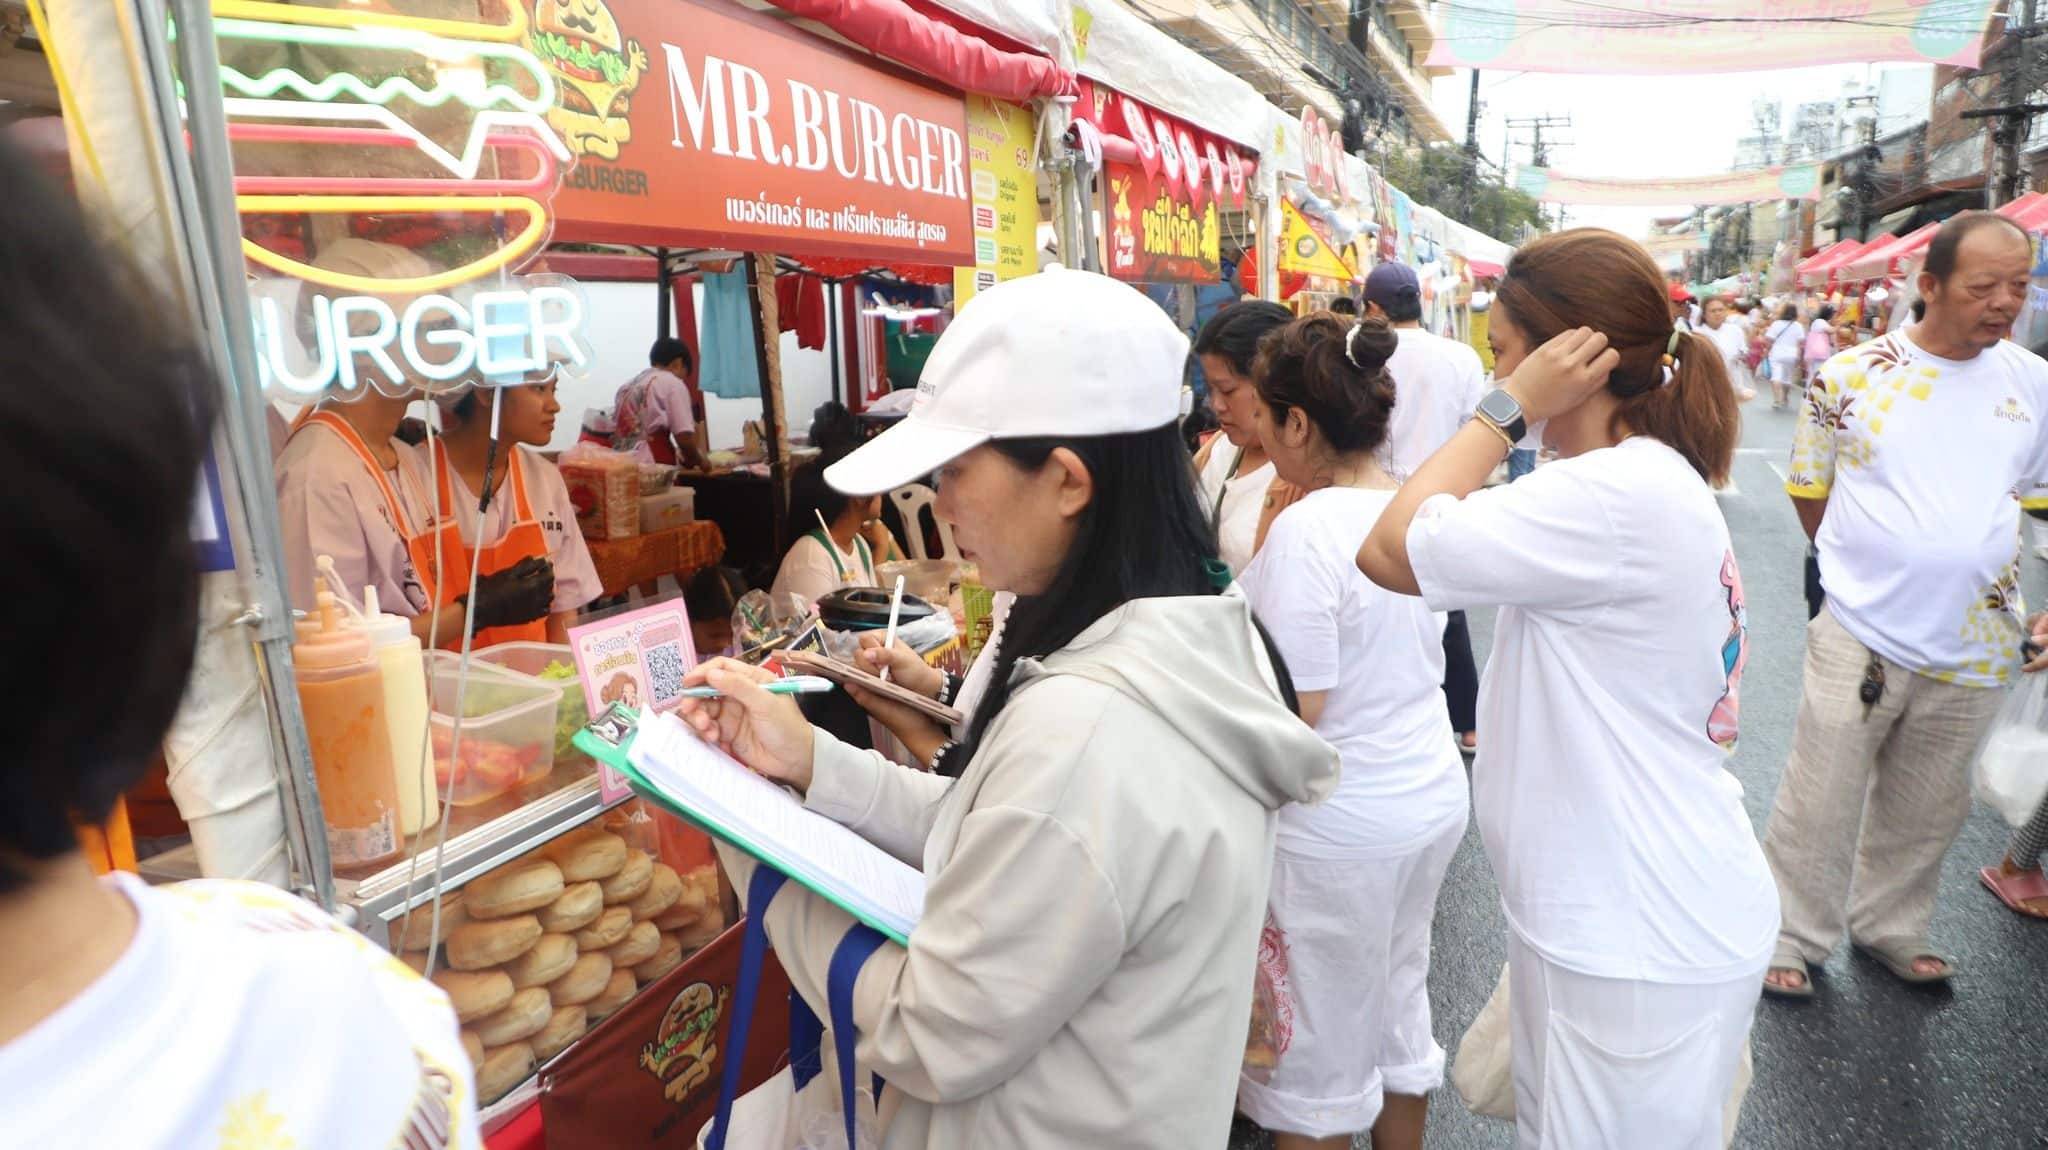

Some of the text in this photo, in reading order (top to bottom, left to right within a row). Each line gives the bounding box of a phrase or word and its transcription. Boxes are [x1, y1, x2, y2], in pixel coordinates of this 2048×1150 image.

[660, 42, 967, 200] MR.BURGER
[725, 191, 802, 227] เบอร์เกอร์
[805, 206, 830, 230] และ
[916, 221, 947, 248] สูตรเจ
